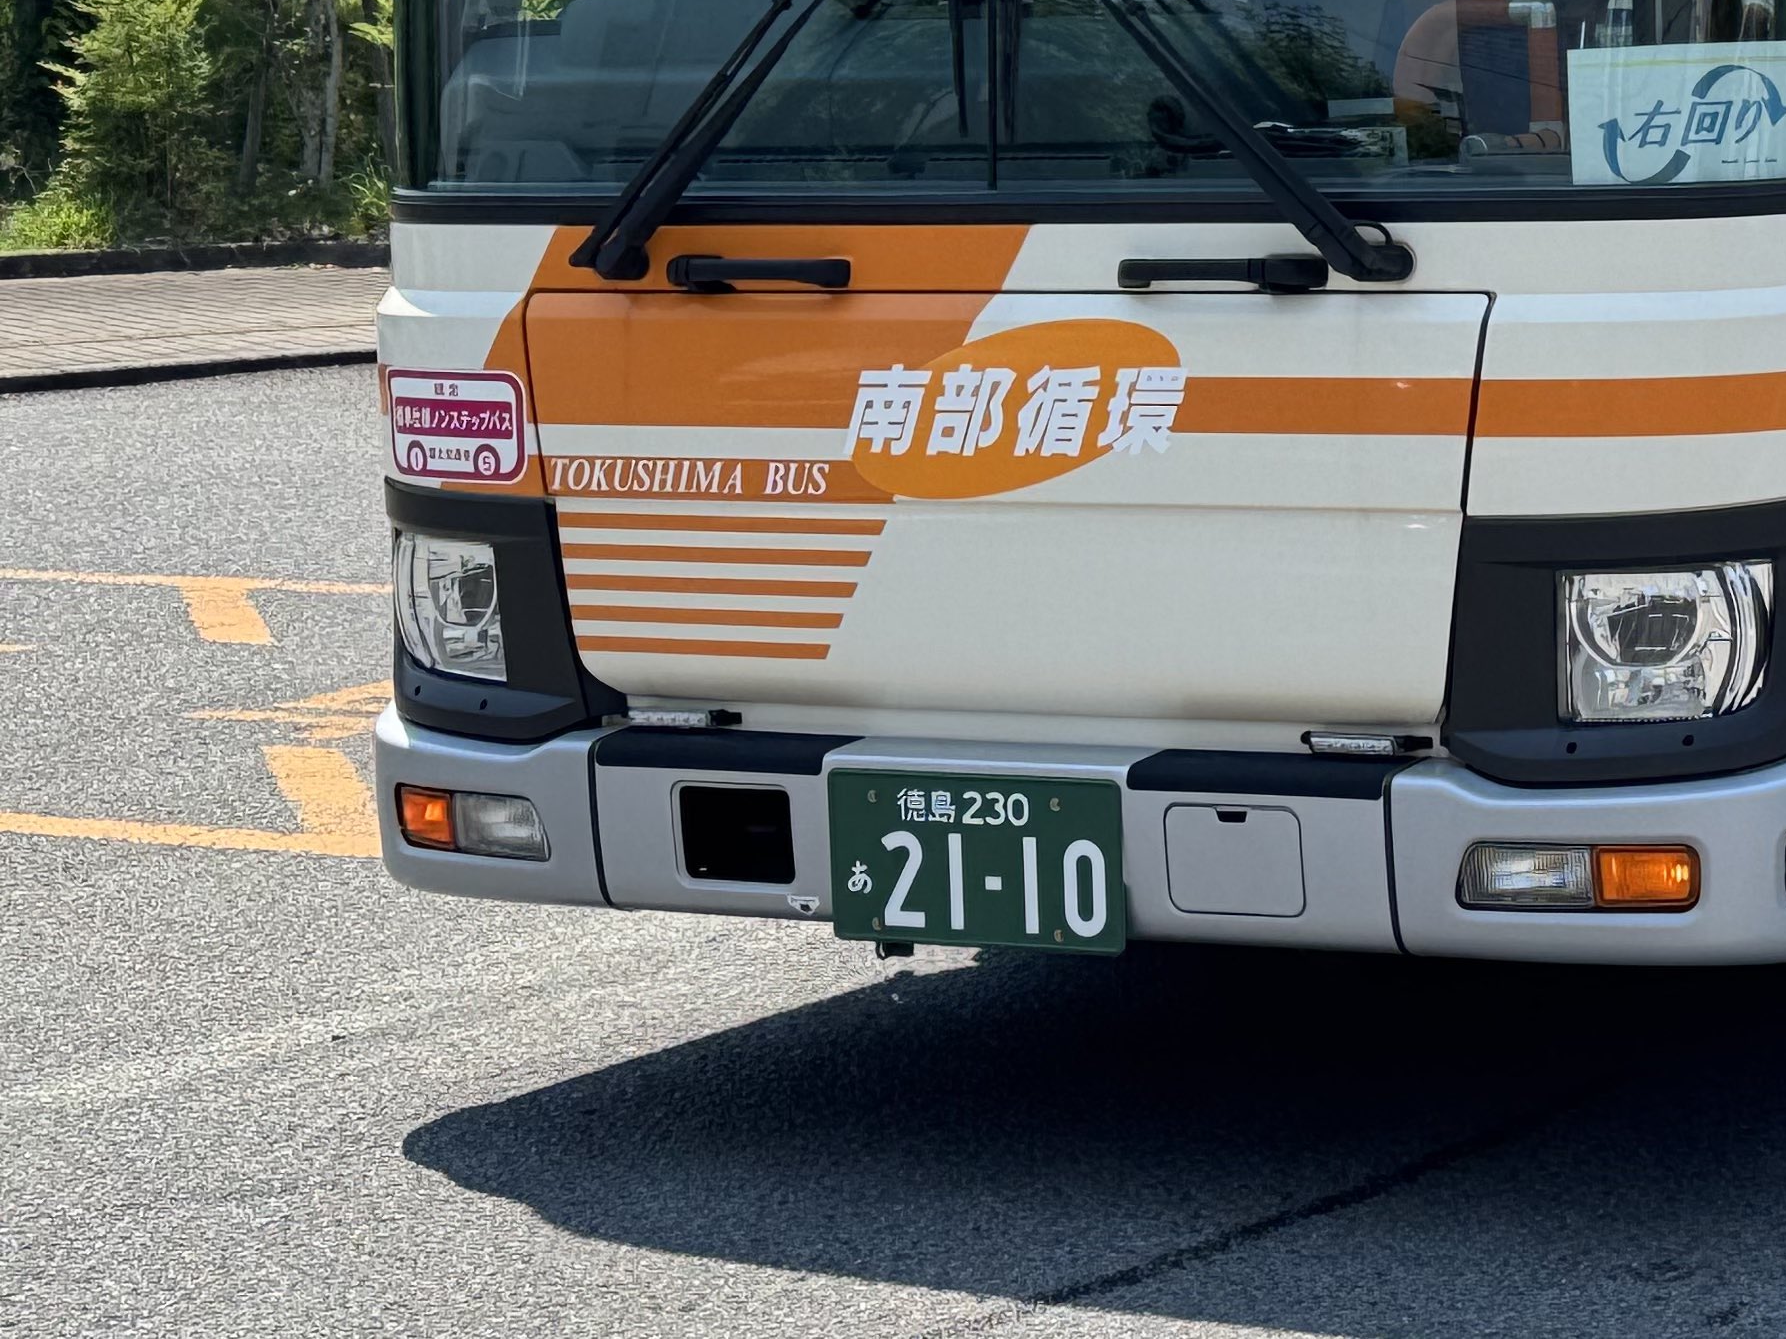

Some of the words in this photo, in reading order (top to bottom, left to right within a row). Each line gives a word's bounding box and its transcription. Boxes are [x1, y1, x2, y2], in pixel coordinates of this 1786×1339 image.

[1627, 98, 1764, 149] 右回り
[842, 362, 1190, 458] 南部循環
[549, 458, 744, 496] TOKUSHIMA
[763, 460, 830, 496] BUS
[847, 860, 873, 894] あ
[880, 830, 1108, 938] 21-10
